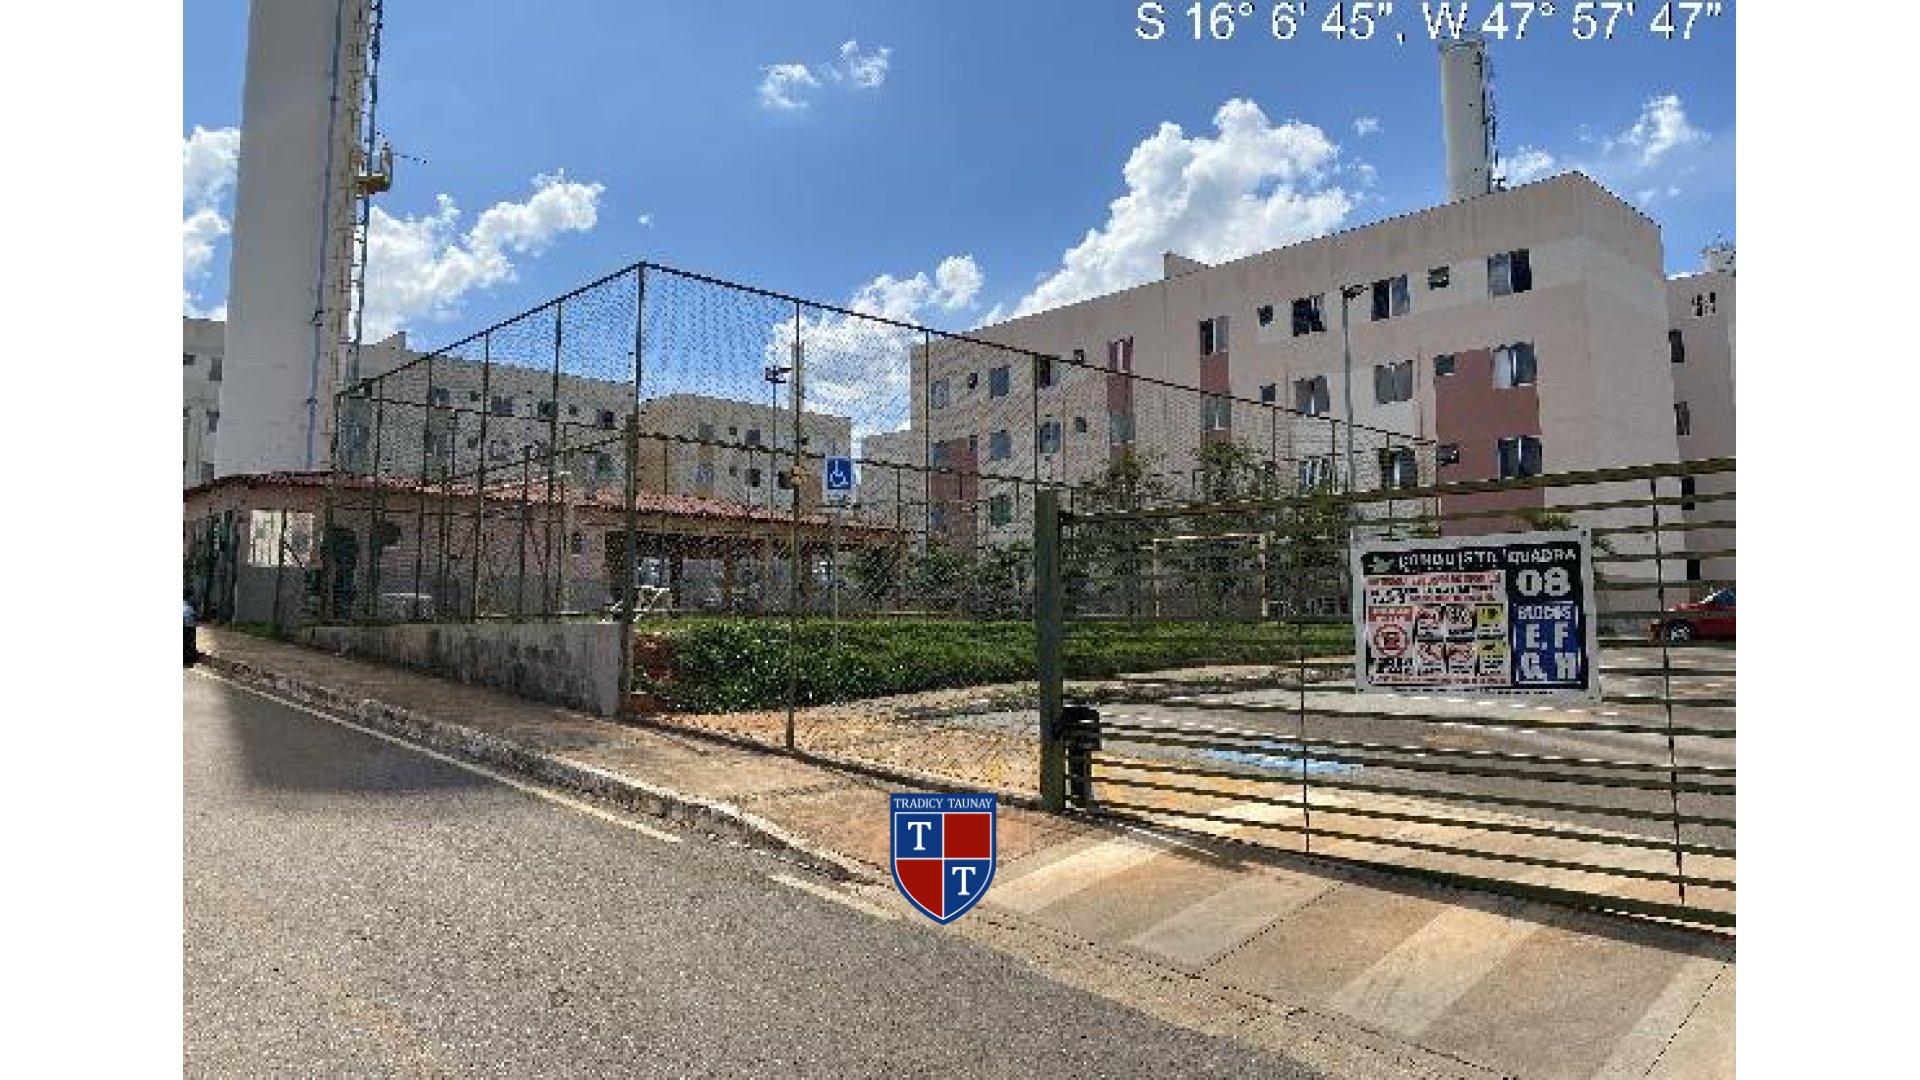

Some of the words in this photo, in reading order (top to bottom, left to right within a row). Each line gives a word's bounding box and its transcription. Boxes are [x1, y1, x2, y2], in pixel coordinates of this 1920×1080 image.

[1507, 548, 1577, 565] QUADRA
[1516, 566, 1571, 596] 08
[1518, 605, 1571, 620] BLOCOS
[1554, 621, 1569, 648] F
[1554, 651, 1577, 680] H
